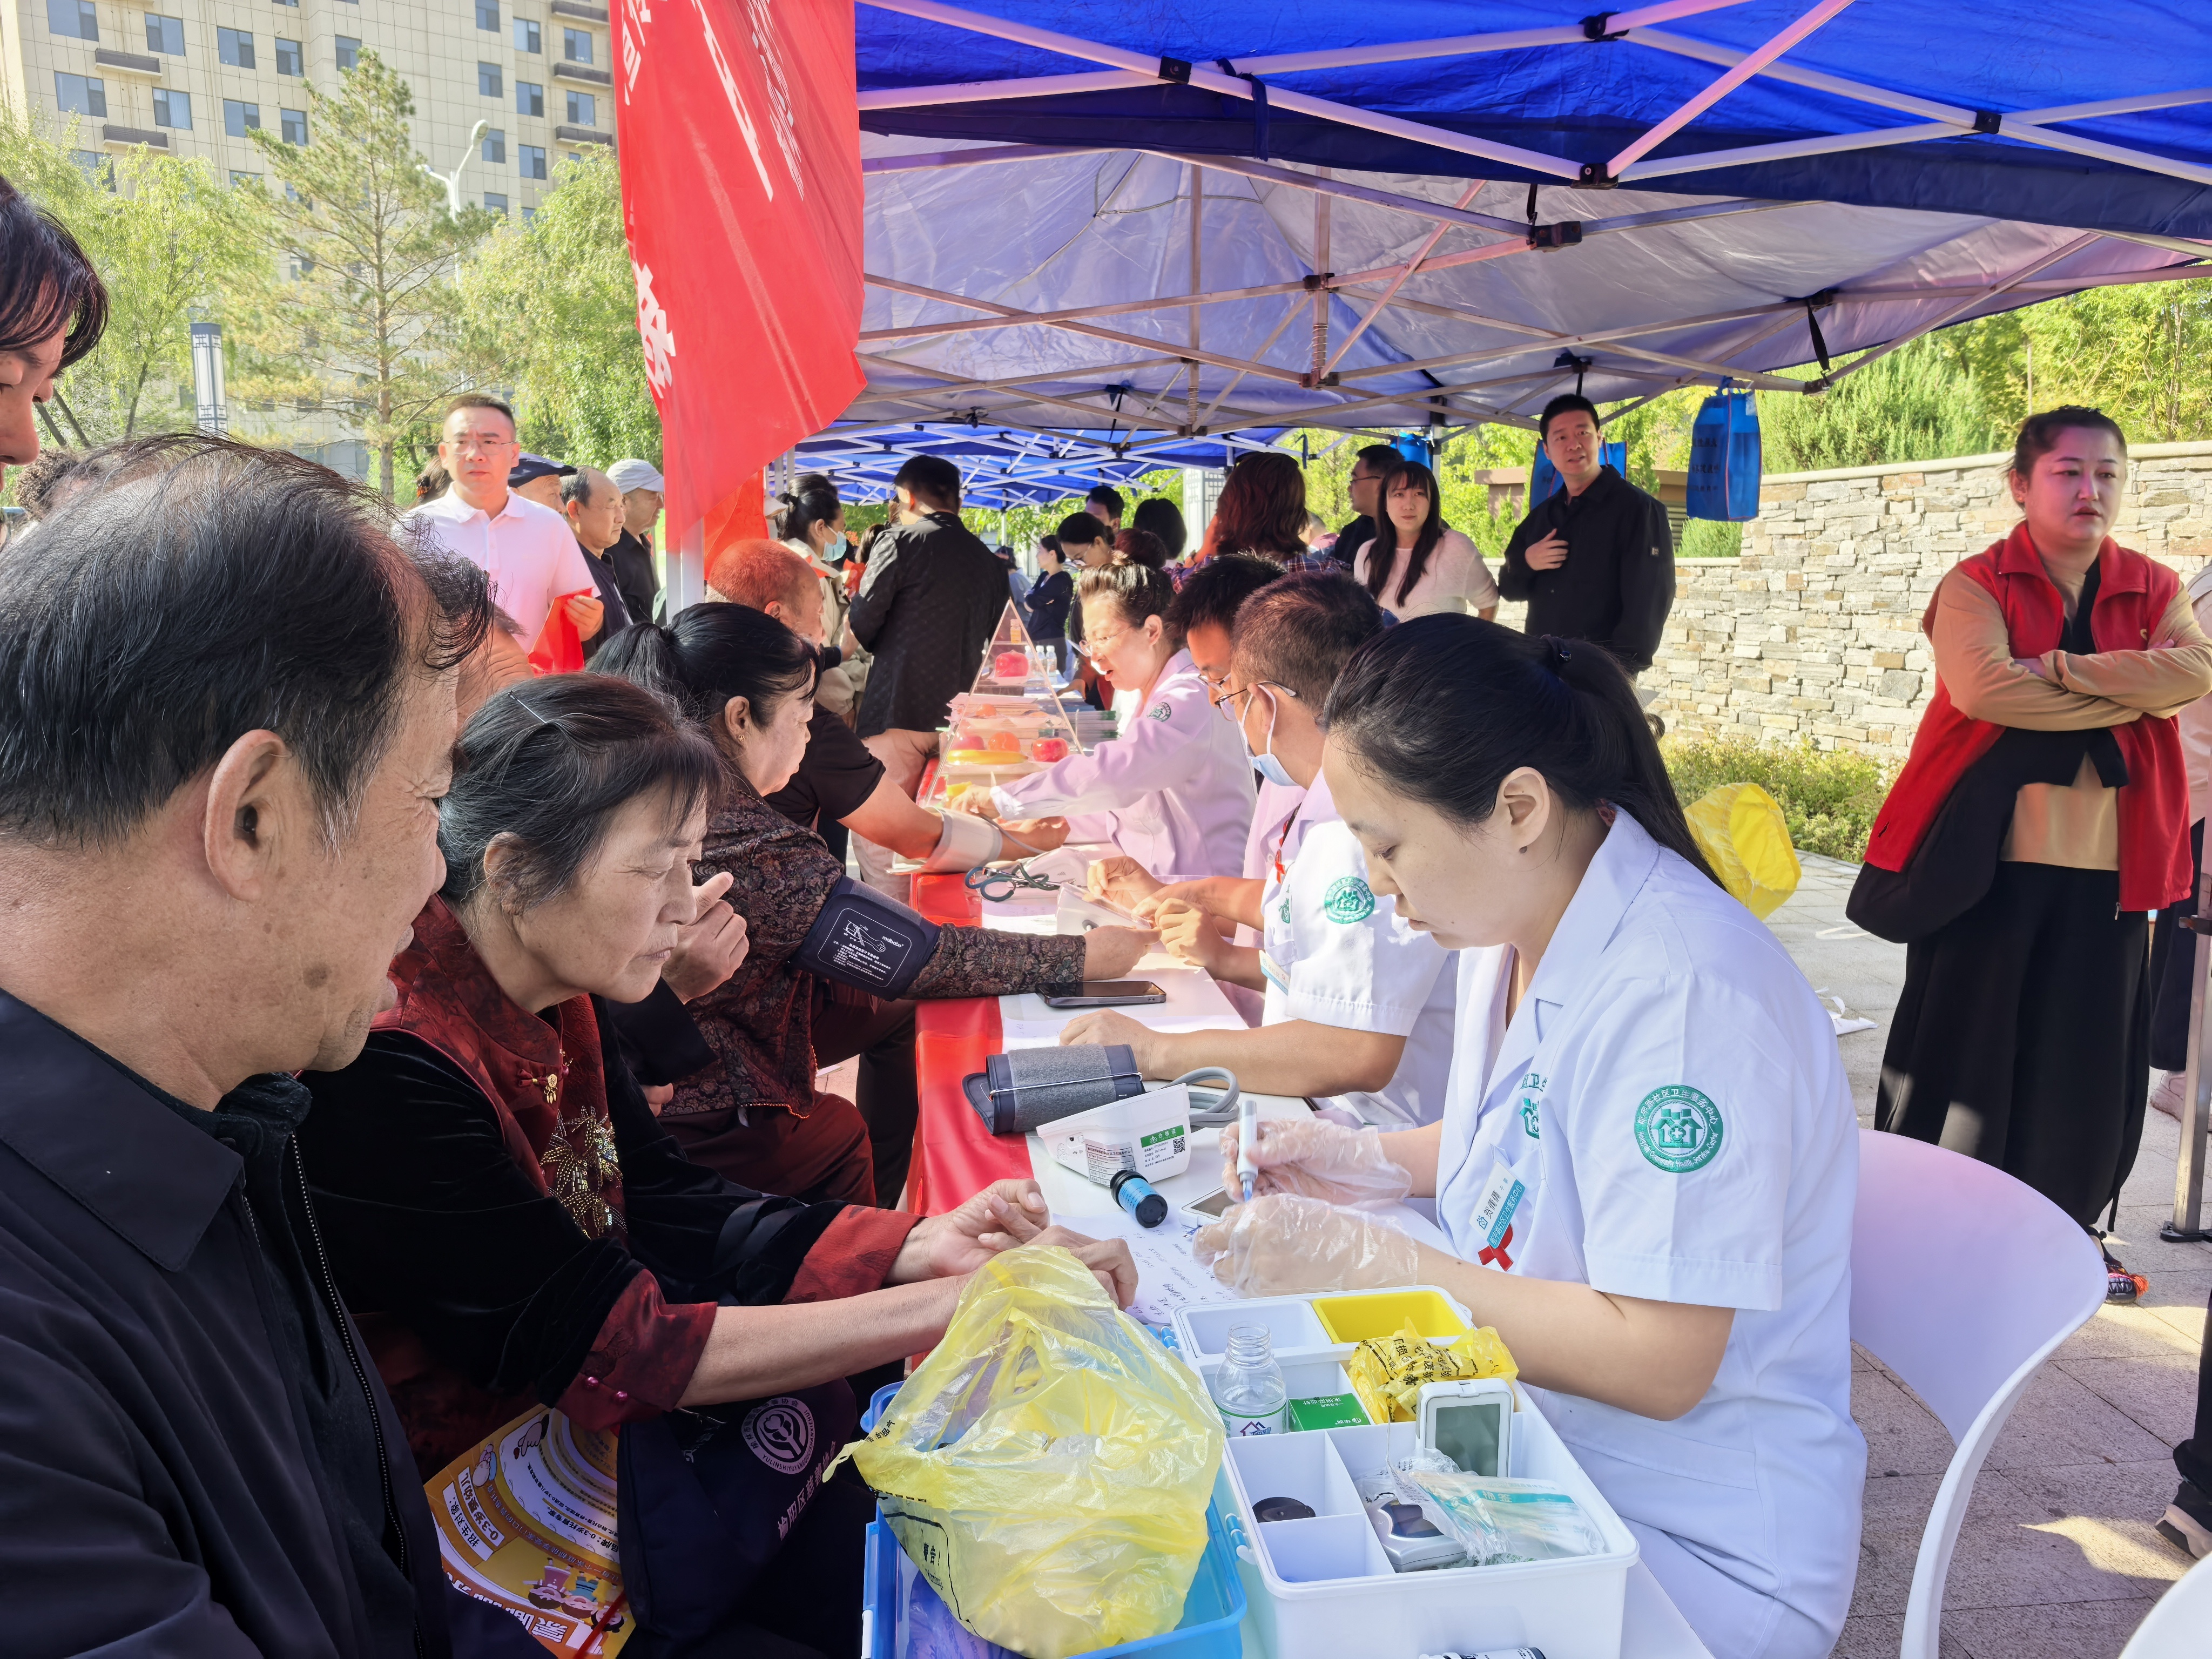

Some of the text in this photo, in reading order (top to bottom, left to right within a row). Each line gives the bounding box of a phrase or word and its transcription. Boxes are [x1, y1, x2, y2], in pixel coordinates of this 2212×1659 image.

[1157, 1127, 1177, 1139] 合格证
[1483, 1190, 1501, 1219] 贺倩倩
[1489, 1183, 1521, 1245] 航宇路社区卫生服务中心
[460, 1470, 499, 1541] 0-3岁婴幼儿
